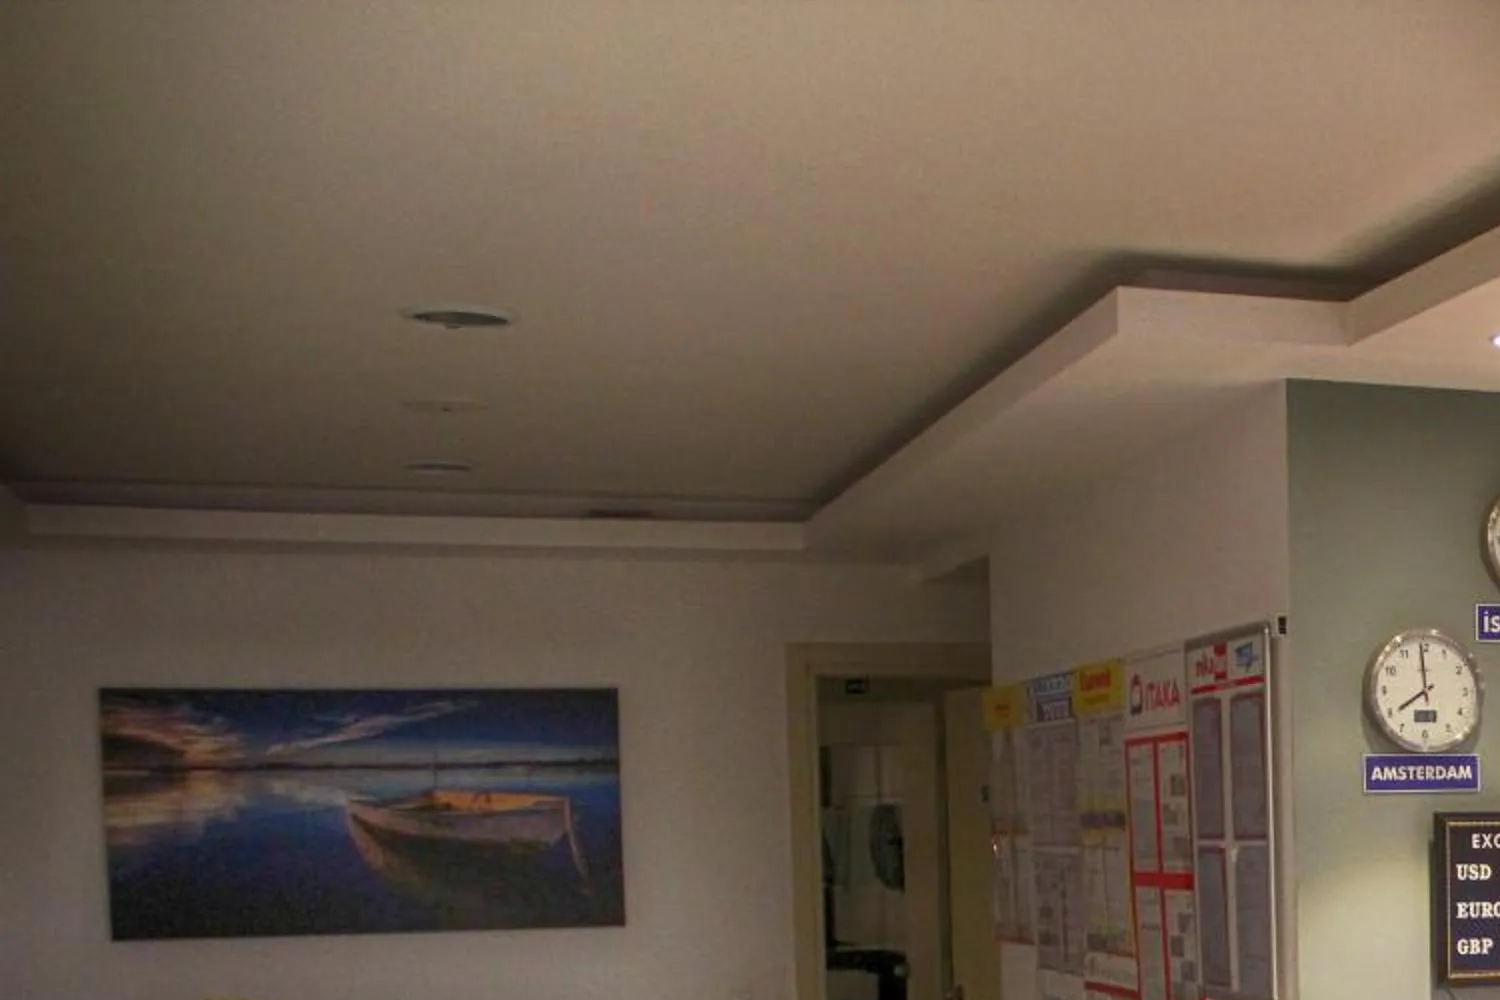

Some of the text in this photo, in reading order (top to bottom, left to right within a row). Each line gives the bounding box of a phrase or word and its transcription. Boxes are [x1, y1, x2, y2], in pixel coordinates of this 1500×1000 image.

[1371, 765, 1473, 780] AMSTERDAM
[1456, 863, 1492, 881] USD
[1457, 937, 1494, 955] GBP
